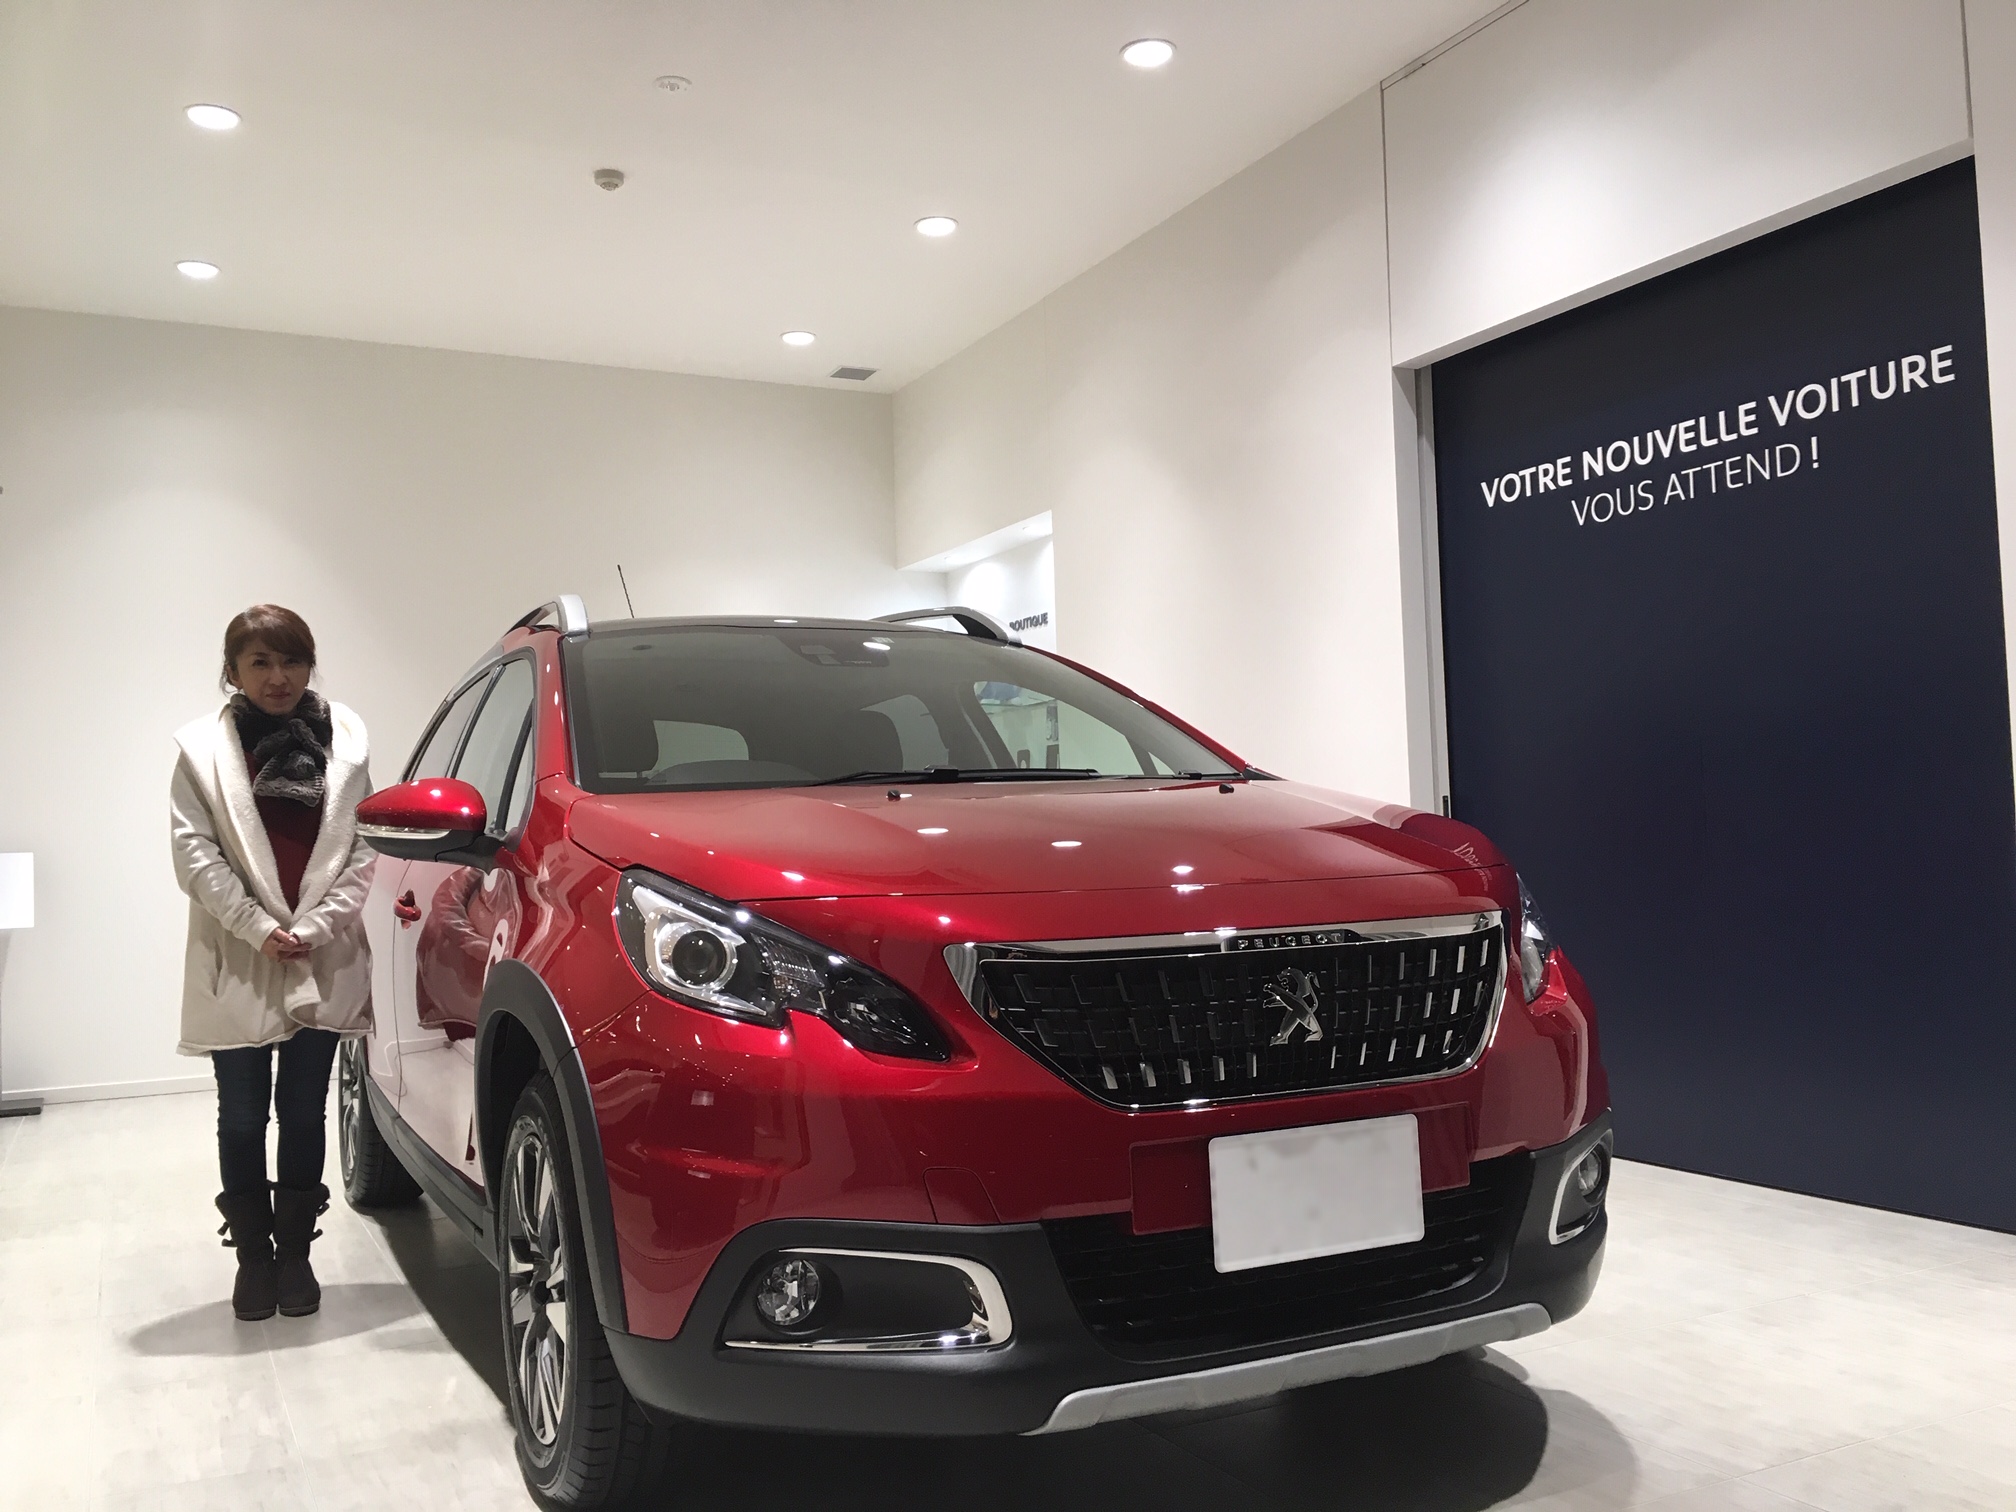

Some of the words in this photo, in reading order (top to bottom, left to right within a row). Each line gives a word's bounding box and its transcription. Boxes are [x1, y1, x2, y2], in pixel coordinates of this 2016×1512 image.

[1481, 456, 1573, 508] VOTRE
[1582, 400, 1759, 481] NOUVELLE
[1767, 344, 1956, 427] VOITURE
[1570, 479, 1655, 526] VOUS
[1009, 612, 1048, 632] BOUTIQUE
[1238, 932, 1342, 950] PEUGEOT
